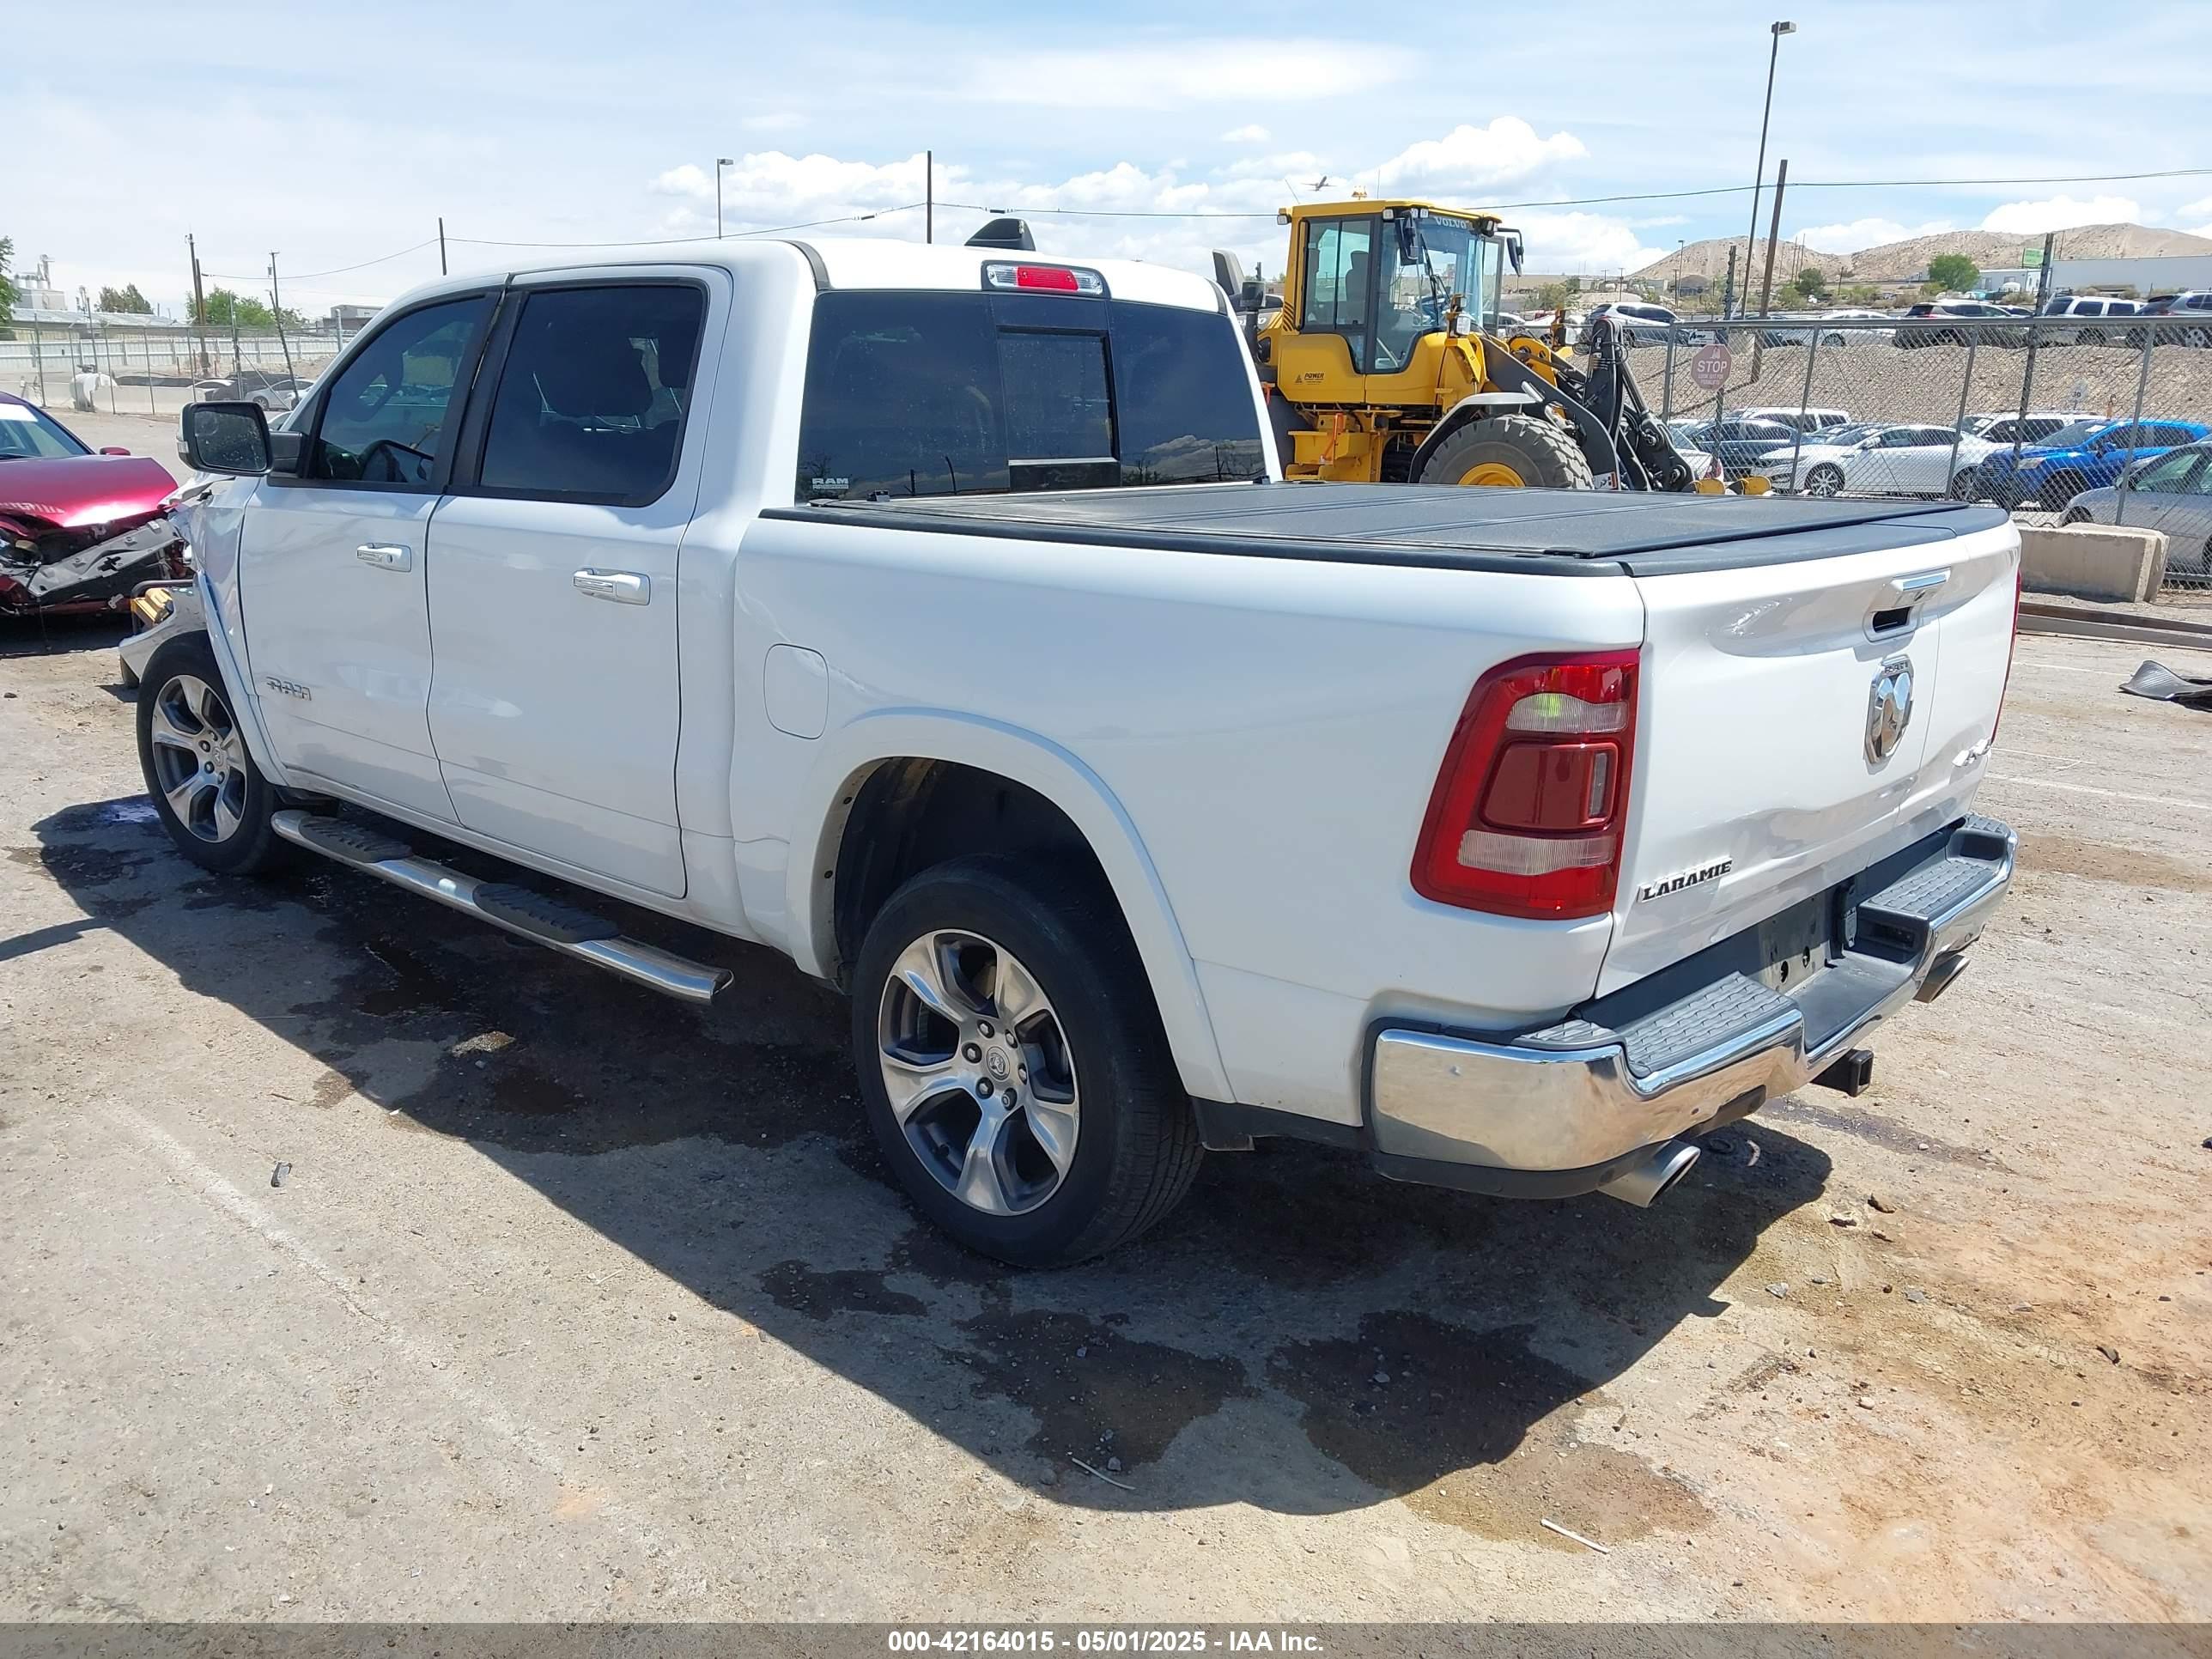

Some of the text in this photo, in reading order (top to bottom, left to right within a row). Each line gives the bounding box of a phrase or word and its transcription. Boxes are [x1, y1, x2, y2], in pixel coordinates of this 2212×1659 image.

[1434, 216, 1467, 229] VOLVO
[1697, 361, 1728, 373] STOP
[265, 676, 312, 701] RAM
[1638, 858, 1734, 902] LARAMIE
